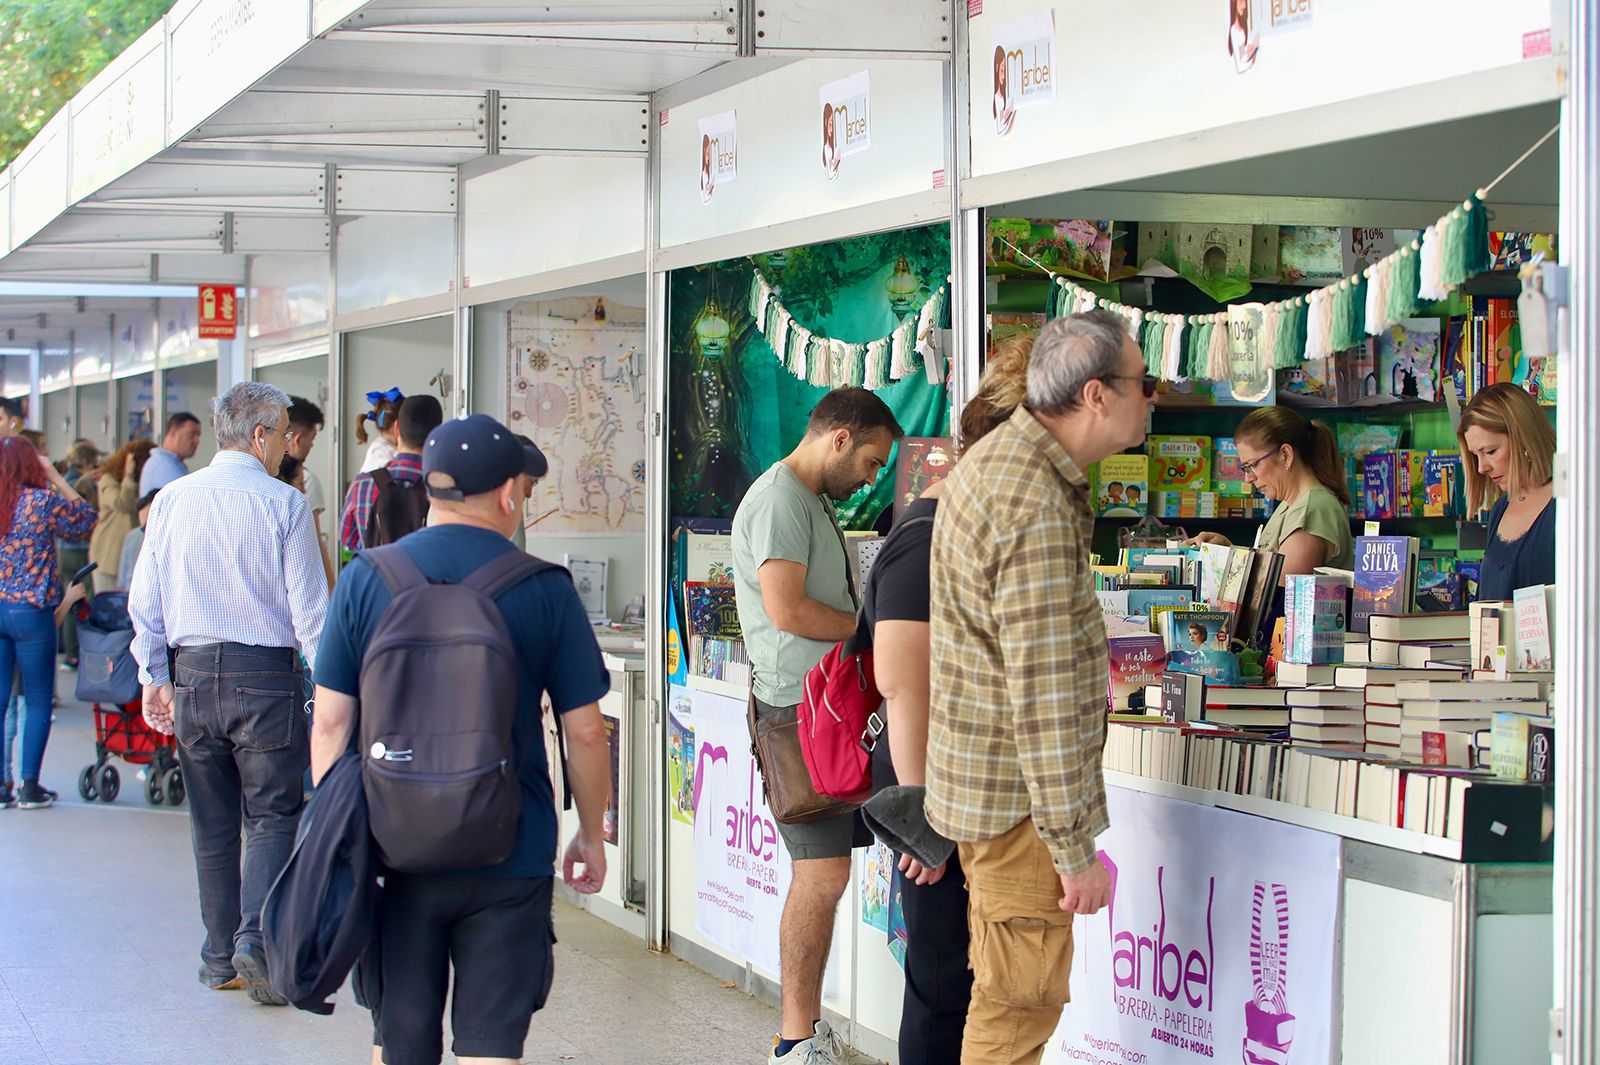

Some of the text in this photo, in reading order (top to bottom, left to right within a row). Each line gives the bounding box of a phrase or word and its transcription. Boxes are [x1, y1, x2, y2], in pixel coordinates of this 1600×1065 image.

[1363, 228, 1384, 240] 10%
[200, 327, 234, 335] EXTINTOR
[1366, 543, 1396, 555] DANIEL
[1362, 554, 1399, 571] SILVA
[1191, 604, 1209, 612] 10%
[1190, 613, 1225, 621] THOMPSON
[1133, 648, 1154, 662] arte
[1124, 668, 1156, 682] nosotros
[1151, 1027, 1214, 1058] ABIERTO 24 HORAS
